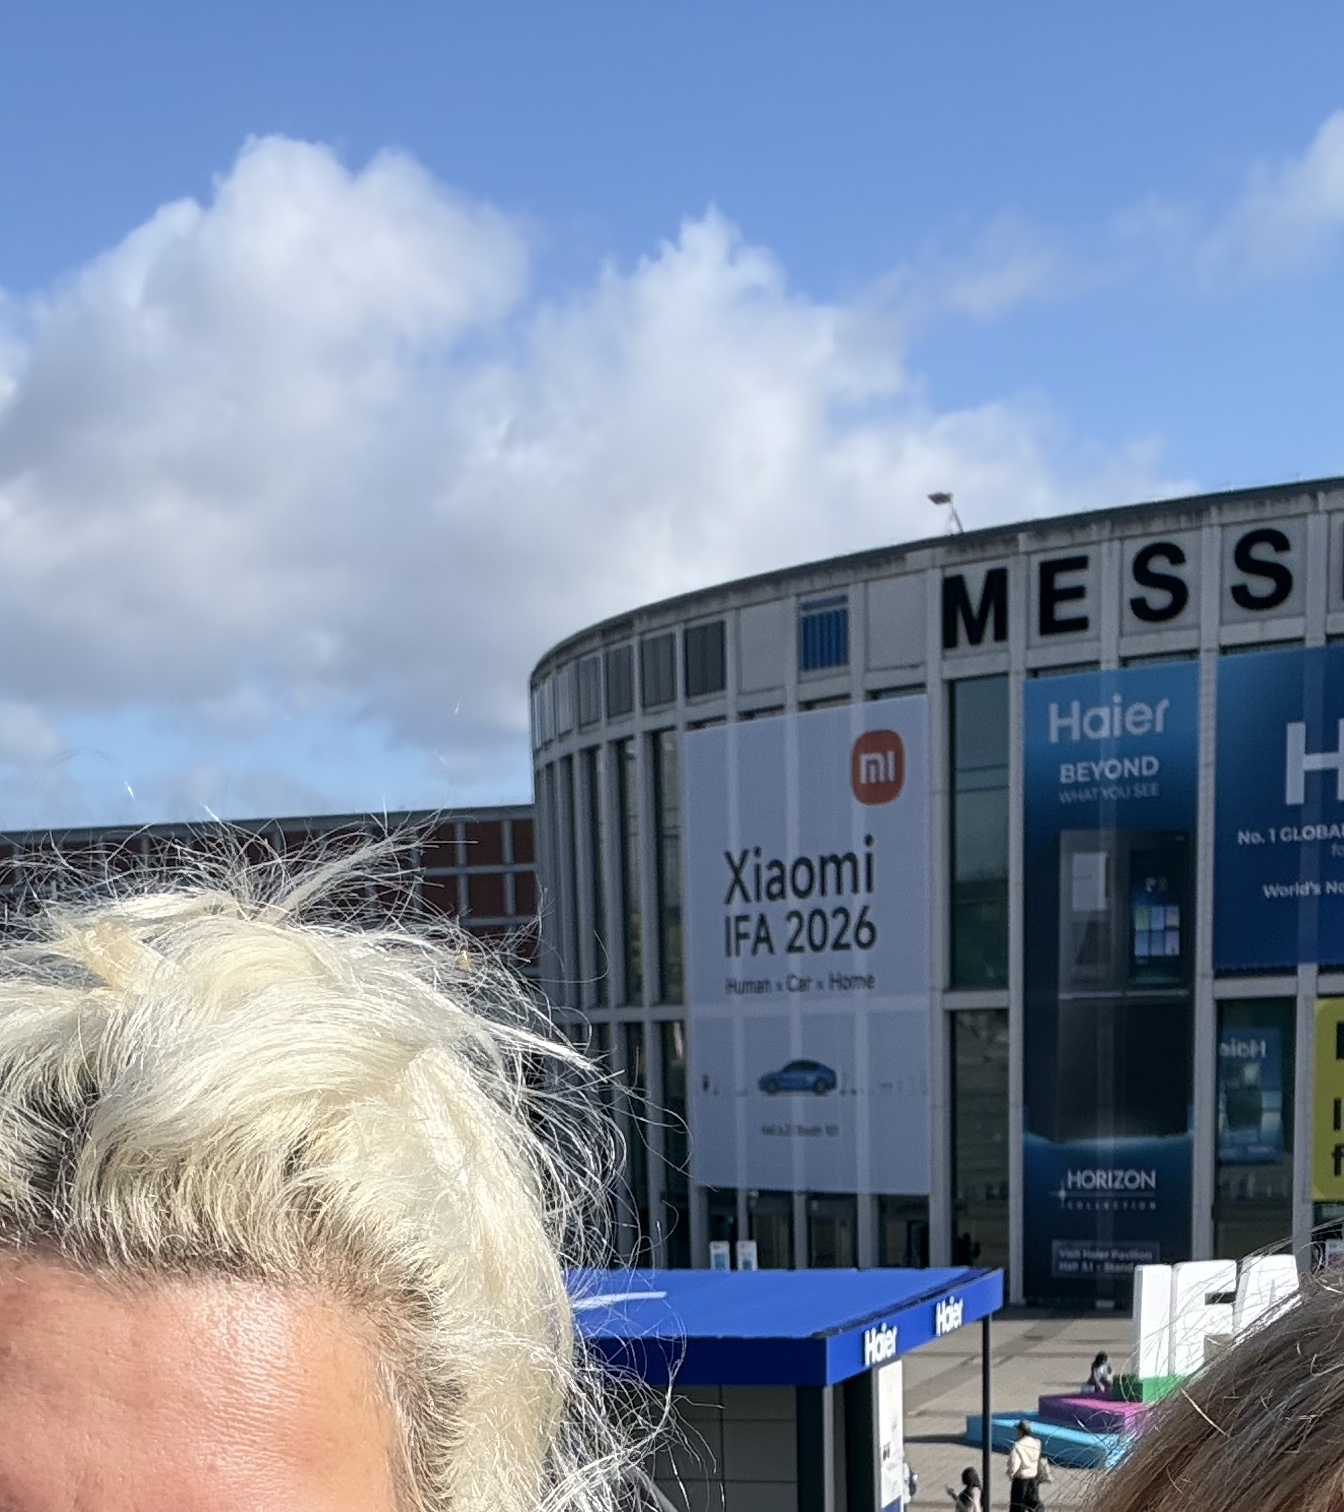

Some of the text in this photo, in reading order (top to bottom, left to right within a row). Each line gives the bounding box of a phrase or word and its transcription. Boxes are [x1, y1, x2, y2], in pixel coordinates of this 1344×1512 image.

[1049, 692, 1170, 744] Haier
[1059, 755, 1160, 784] BEYOND
[1102, 785, 1131, 800] YOU
[1237, 829, 1265, 845] No.
[723, 833, 875, 905] Xiaomi
[1262, 880, 1321, 899] World's
[725, 905, 877, 957] IFA 2026
[725, 976, 772, 995] Human
[786, 974, 813, 992] Car
[828, 971, 876, 991] Home
[1067, 1169, 1156, 1190] HORIZON
